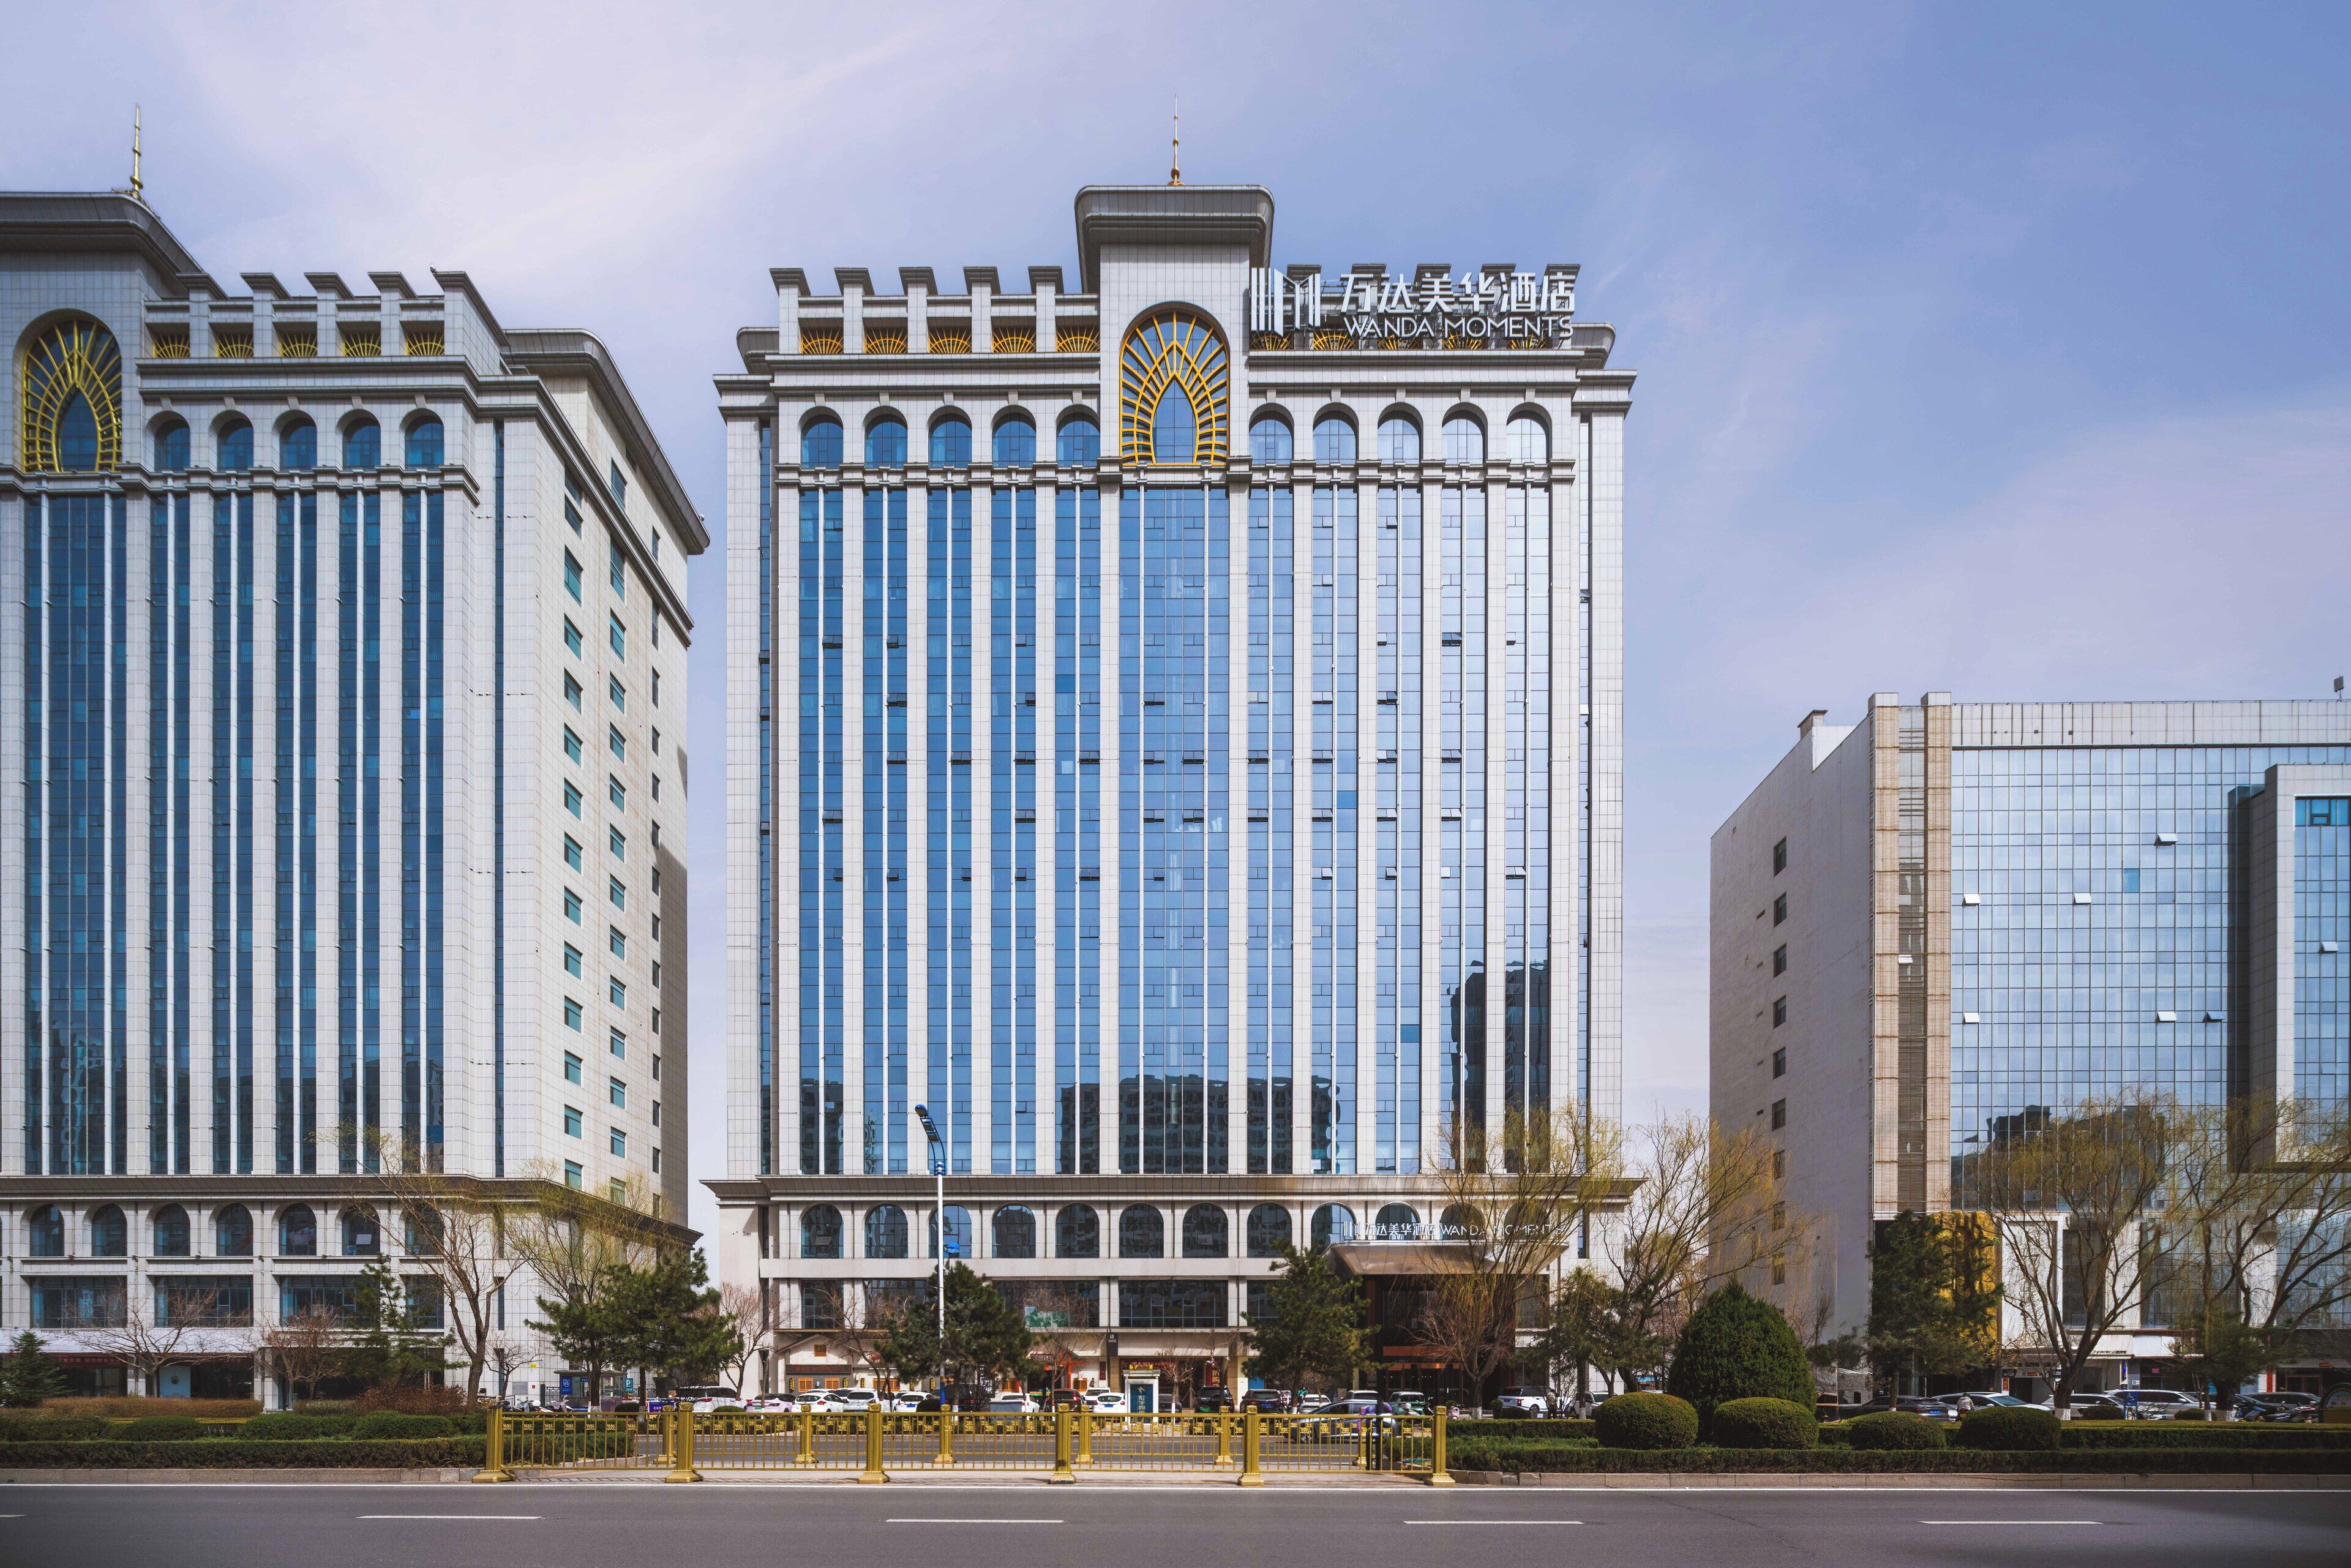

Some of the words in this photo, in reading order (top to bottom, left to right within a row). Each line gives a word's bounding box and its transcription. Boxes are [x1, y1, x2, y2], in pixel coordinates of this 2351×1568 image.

[1340, 272, 1576, 313] 万达美华酒店
[1344, 317, 1434, 337] WANDA
[1445, 317, 1573, 337] MOMENTS
[1365, 1223, 1435, 1236] 万达美华酒店
